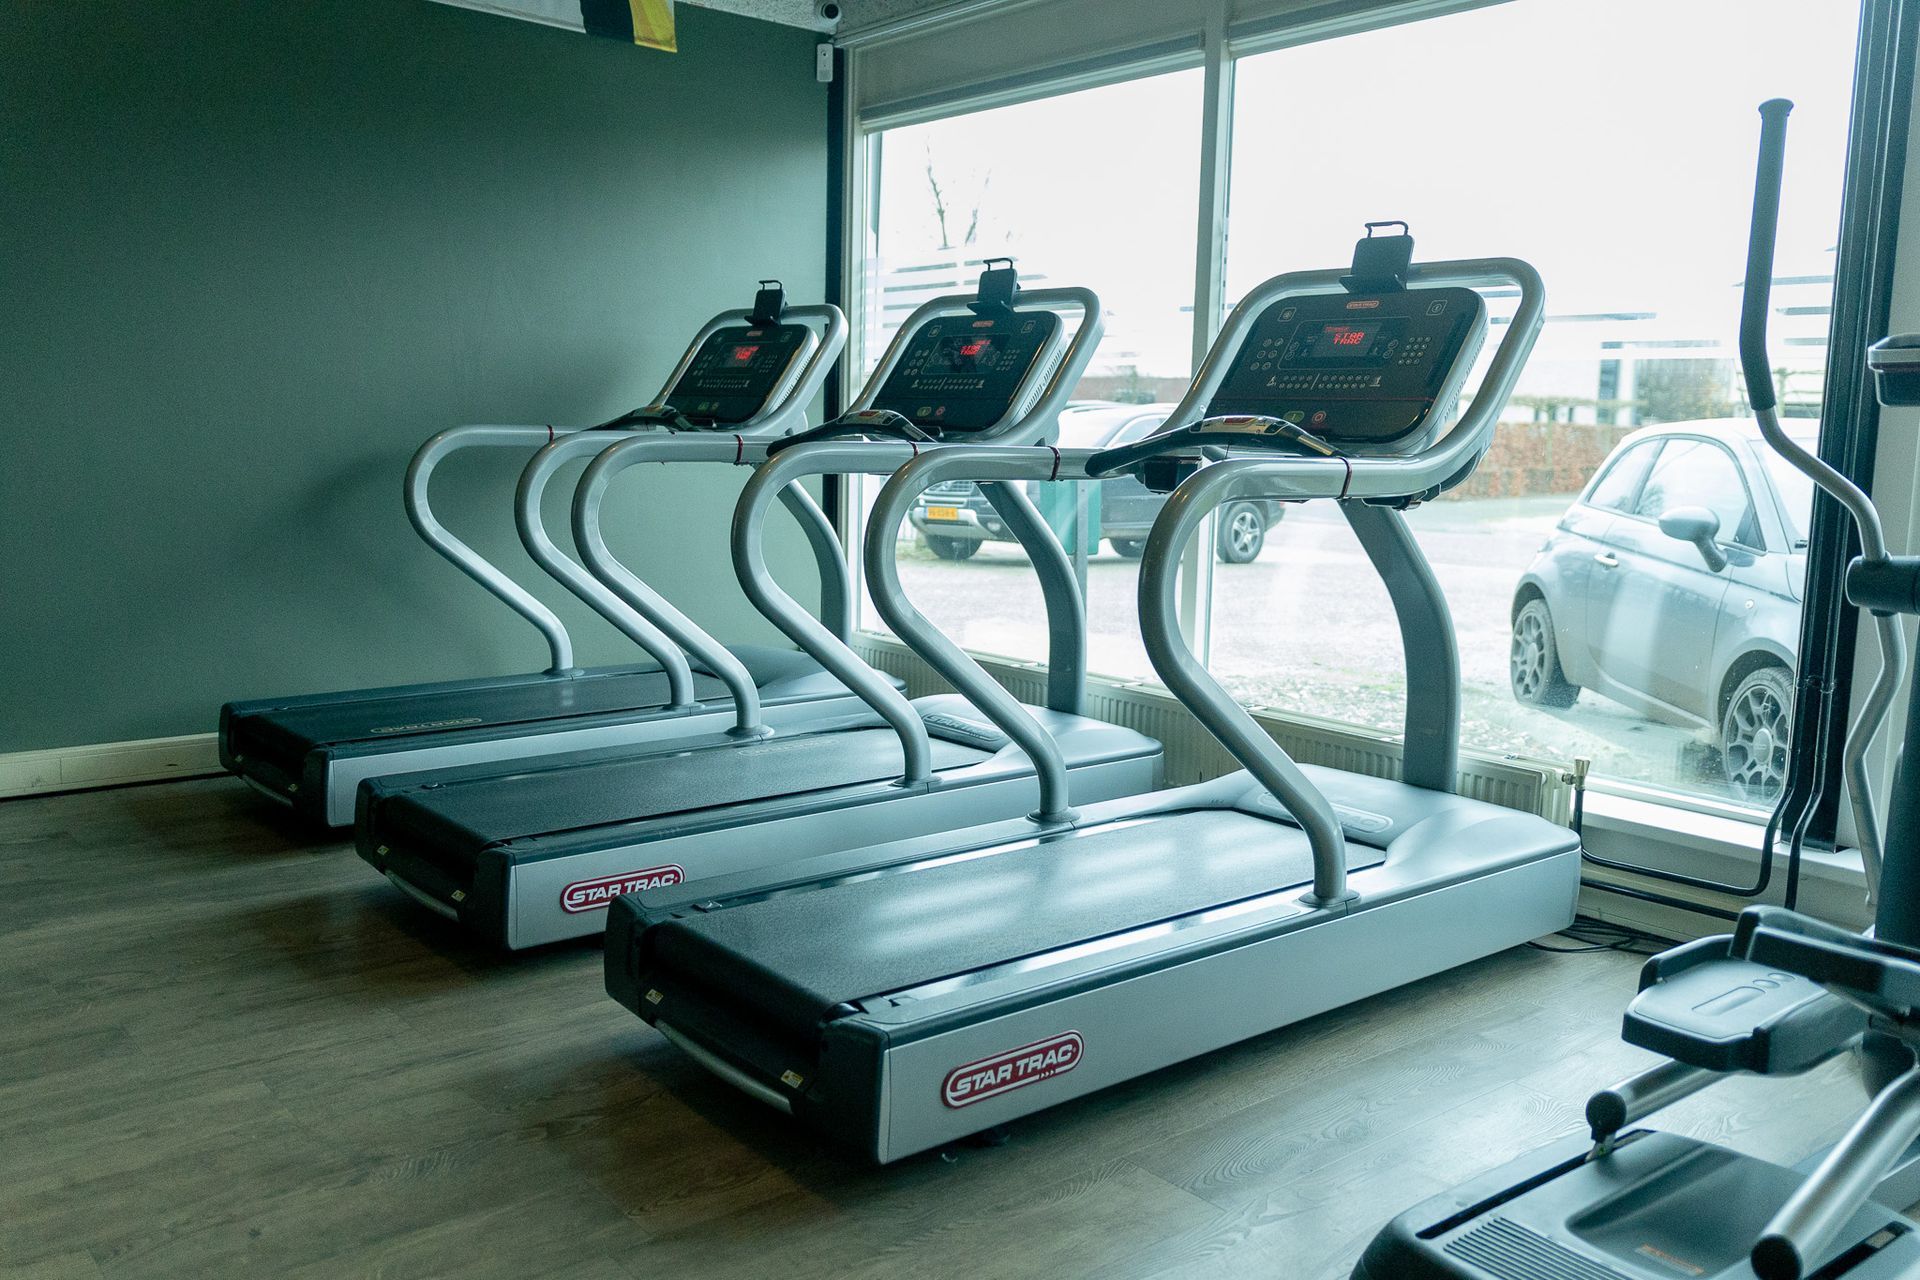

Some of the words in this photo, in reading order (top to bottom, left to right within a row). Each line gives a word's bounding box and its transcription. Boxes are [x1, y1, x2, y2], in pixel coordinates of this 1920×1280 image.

[571, 884, 622, 903] STAR
[624, 873, 675, 893] TRAC
[954, 1063, 1013, 1097] STAR
[1016, 1044, 1073, 1076] TRAC
